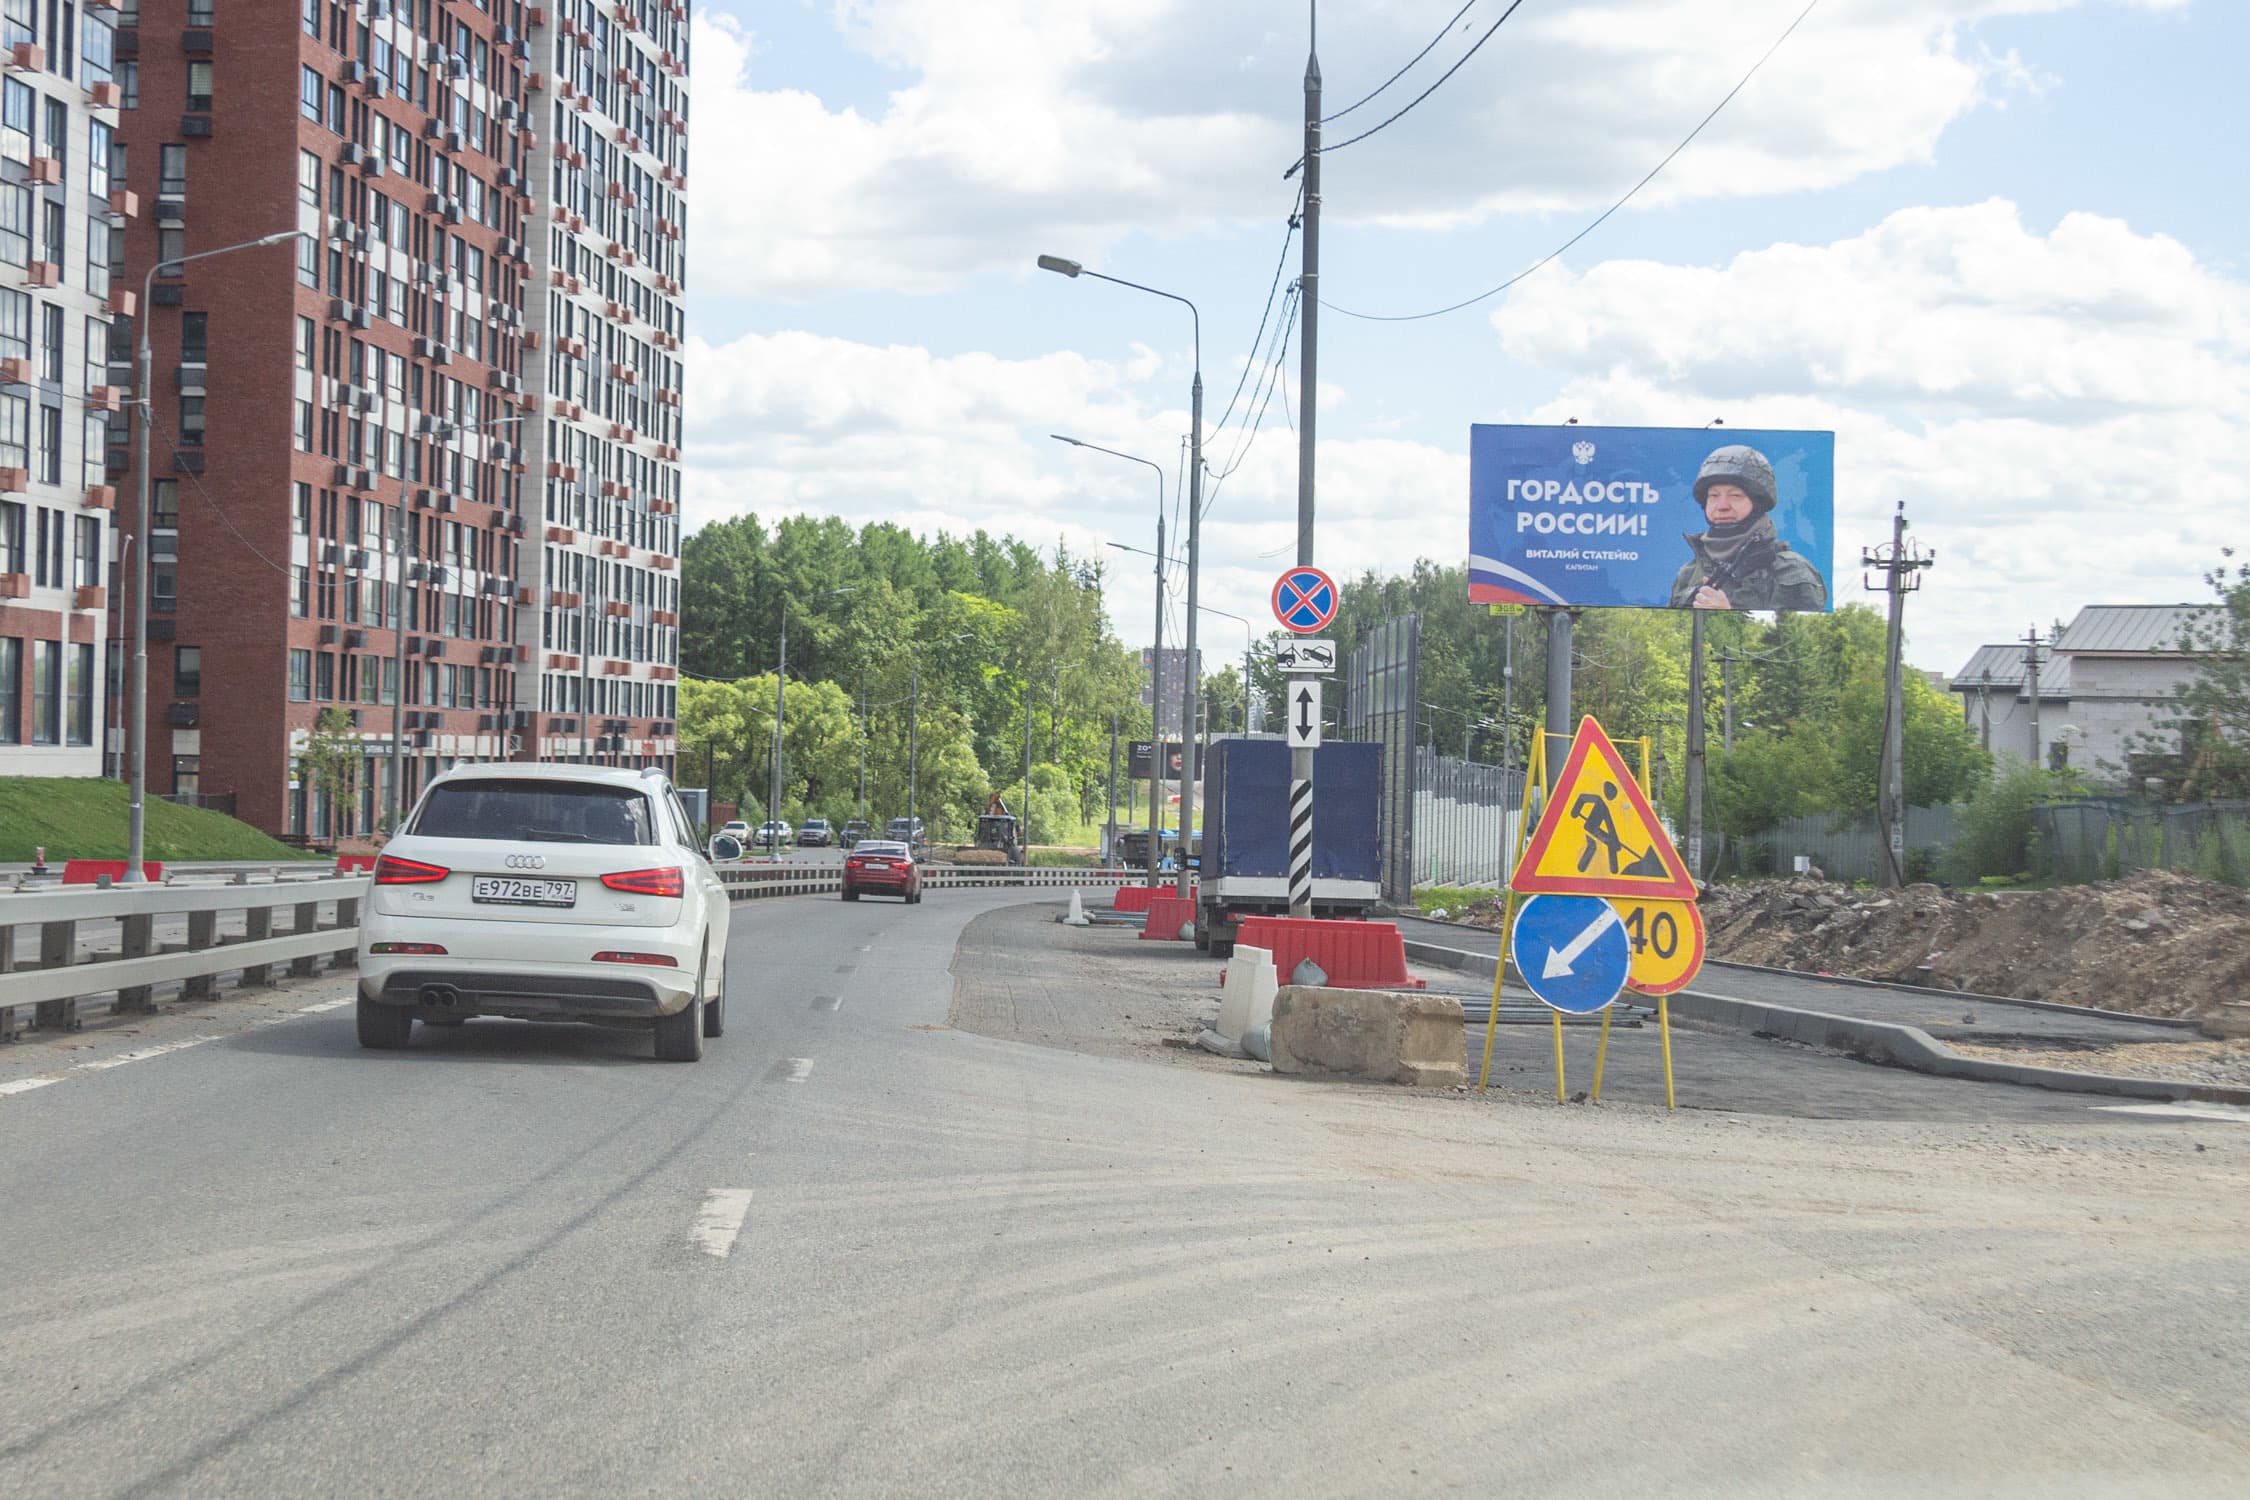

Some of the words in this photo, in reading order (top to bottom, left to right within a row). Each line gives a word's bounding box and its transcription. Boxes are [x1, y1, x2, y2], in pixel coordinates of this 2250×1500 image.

[1507, 479, 1660, 505] ГОРДОСТЬ
[1516, 511, 1648, 536] РОССИИ!
[1525, 548, 1579, 560] ВИТАЛИЙ
[1582, 549, 1639, 561] СТАТЕЙКО
[546, 882, 572, 895] 797
[1625, 906, 1678, 959] 40
